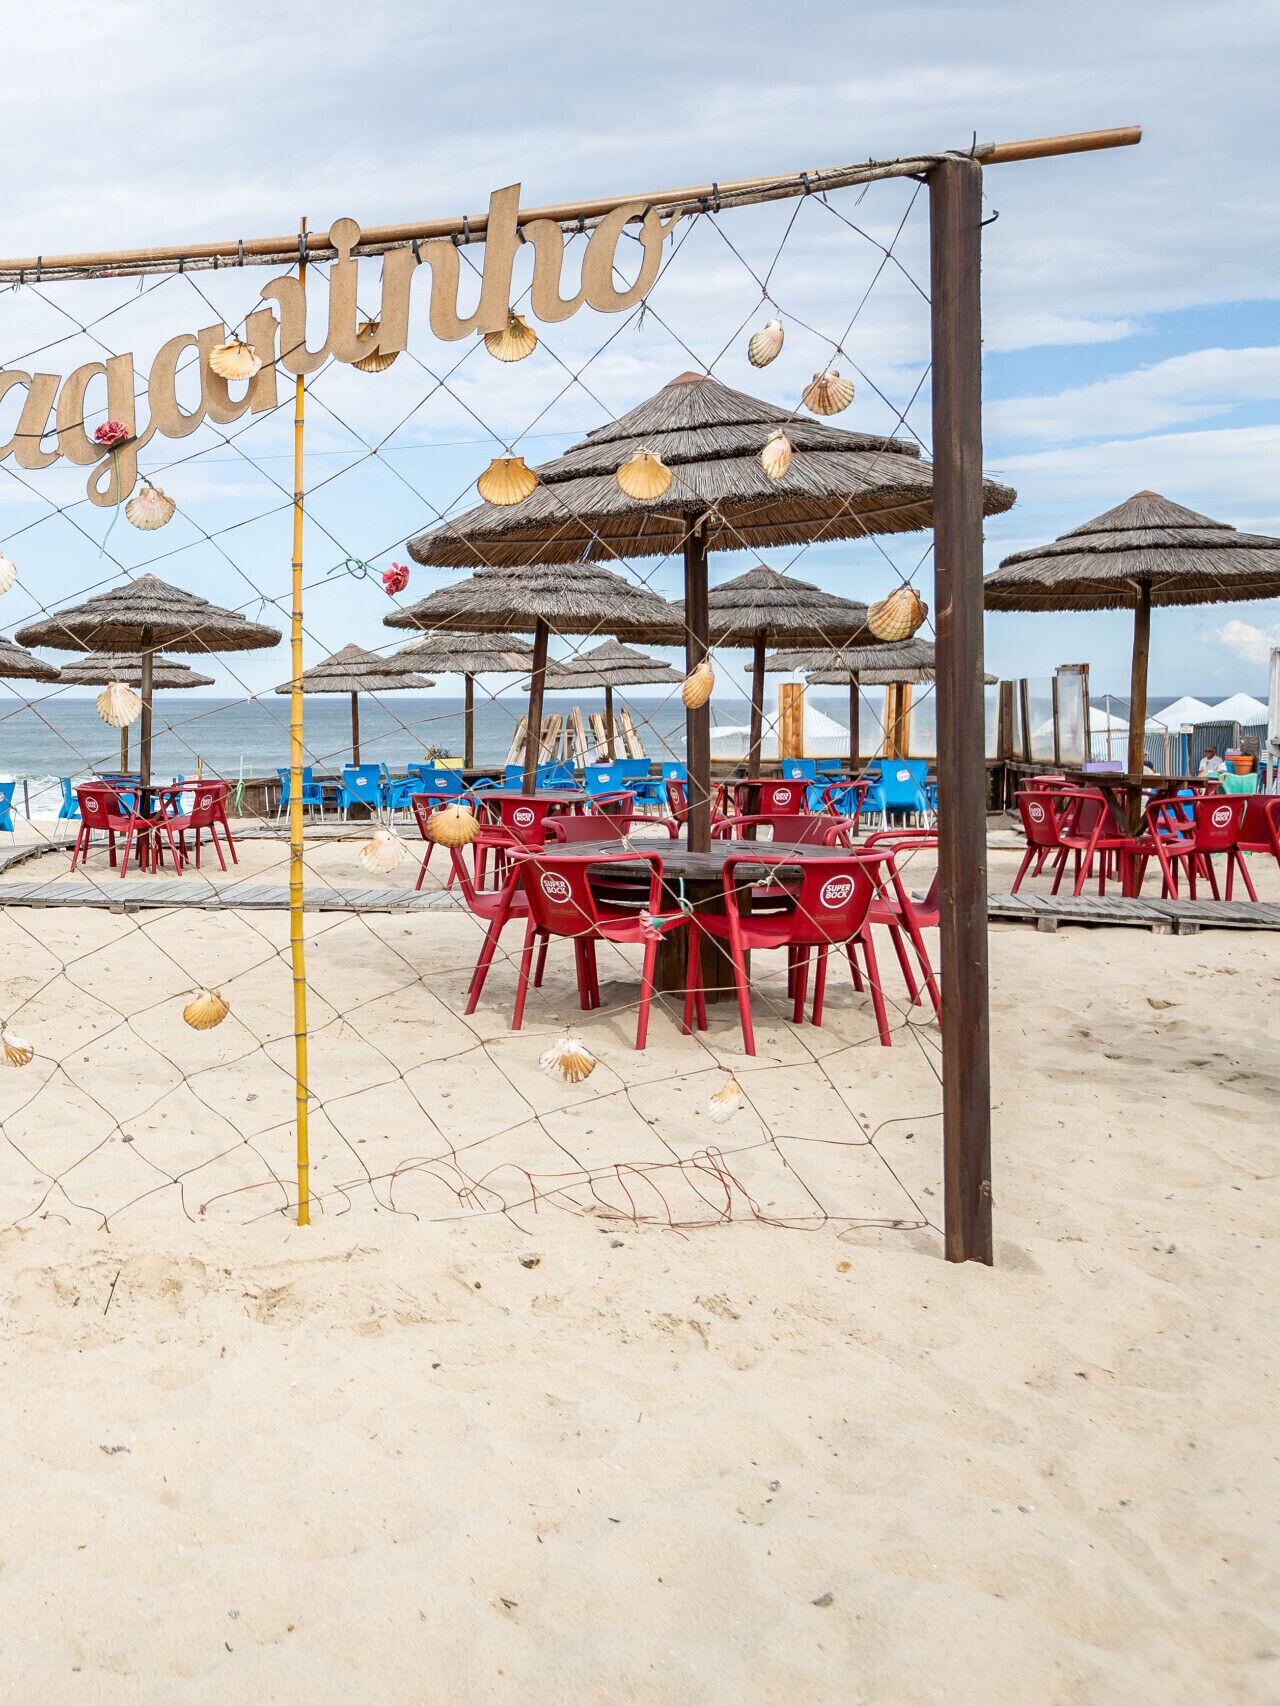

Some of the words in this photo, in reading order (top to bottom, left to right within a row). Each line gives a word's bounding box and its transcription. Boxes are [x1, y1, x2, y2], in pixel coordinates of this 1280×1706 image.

[543, 880, 566, 888] SUPER
[825, 884, 851, 892] SUPER
[825, 891, 848, 899] BOCK
